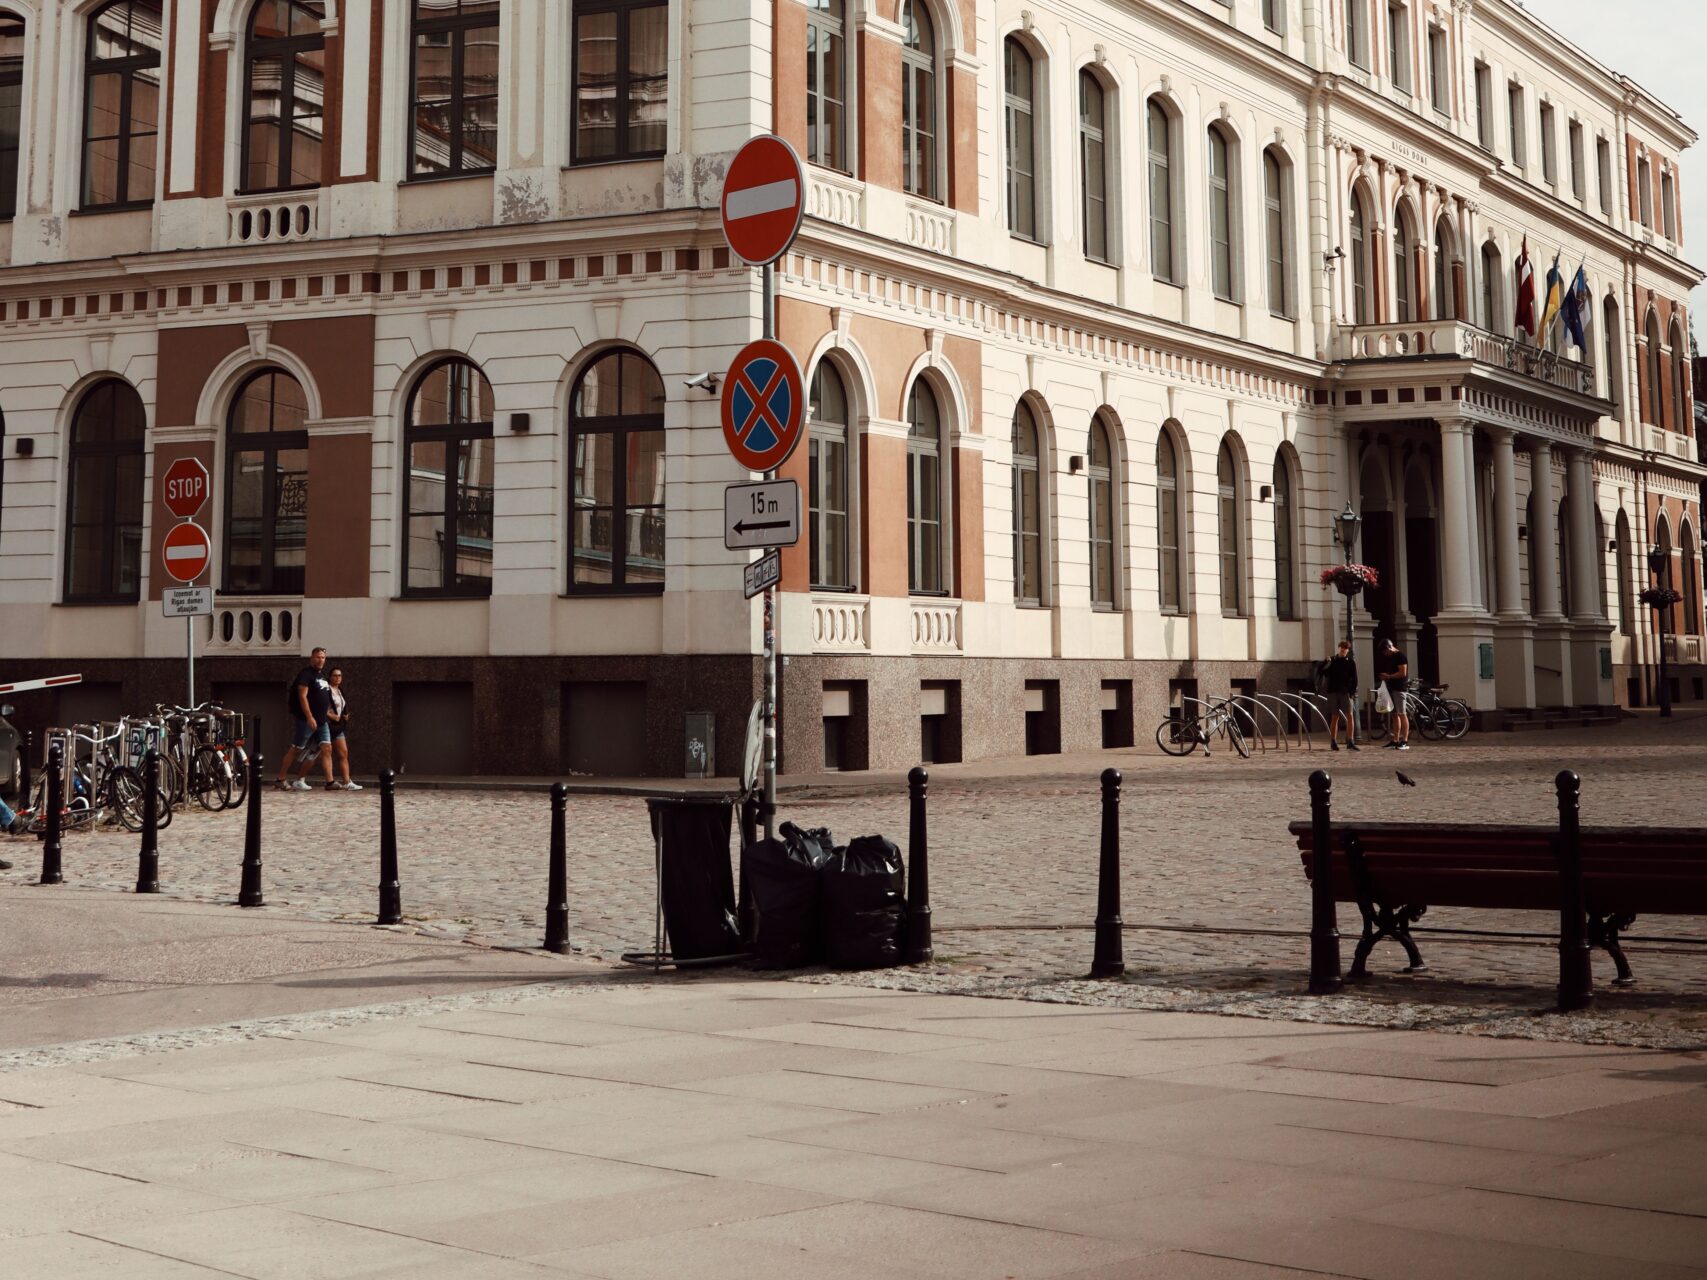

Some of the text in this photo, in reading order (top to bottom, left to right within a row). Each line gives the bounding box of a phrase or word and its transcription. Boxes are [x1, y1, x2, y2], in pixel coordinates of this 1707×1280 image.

[168, 477, 203, 500] STOP
[750, 491, 778, 515] 15 m
